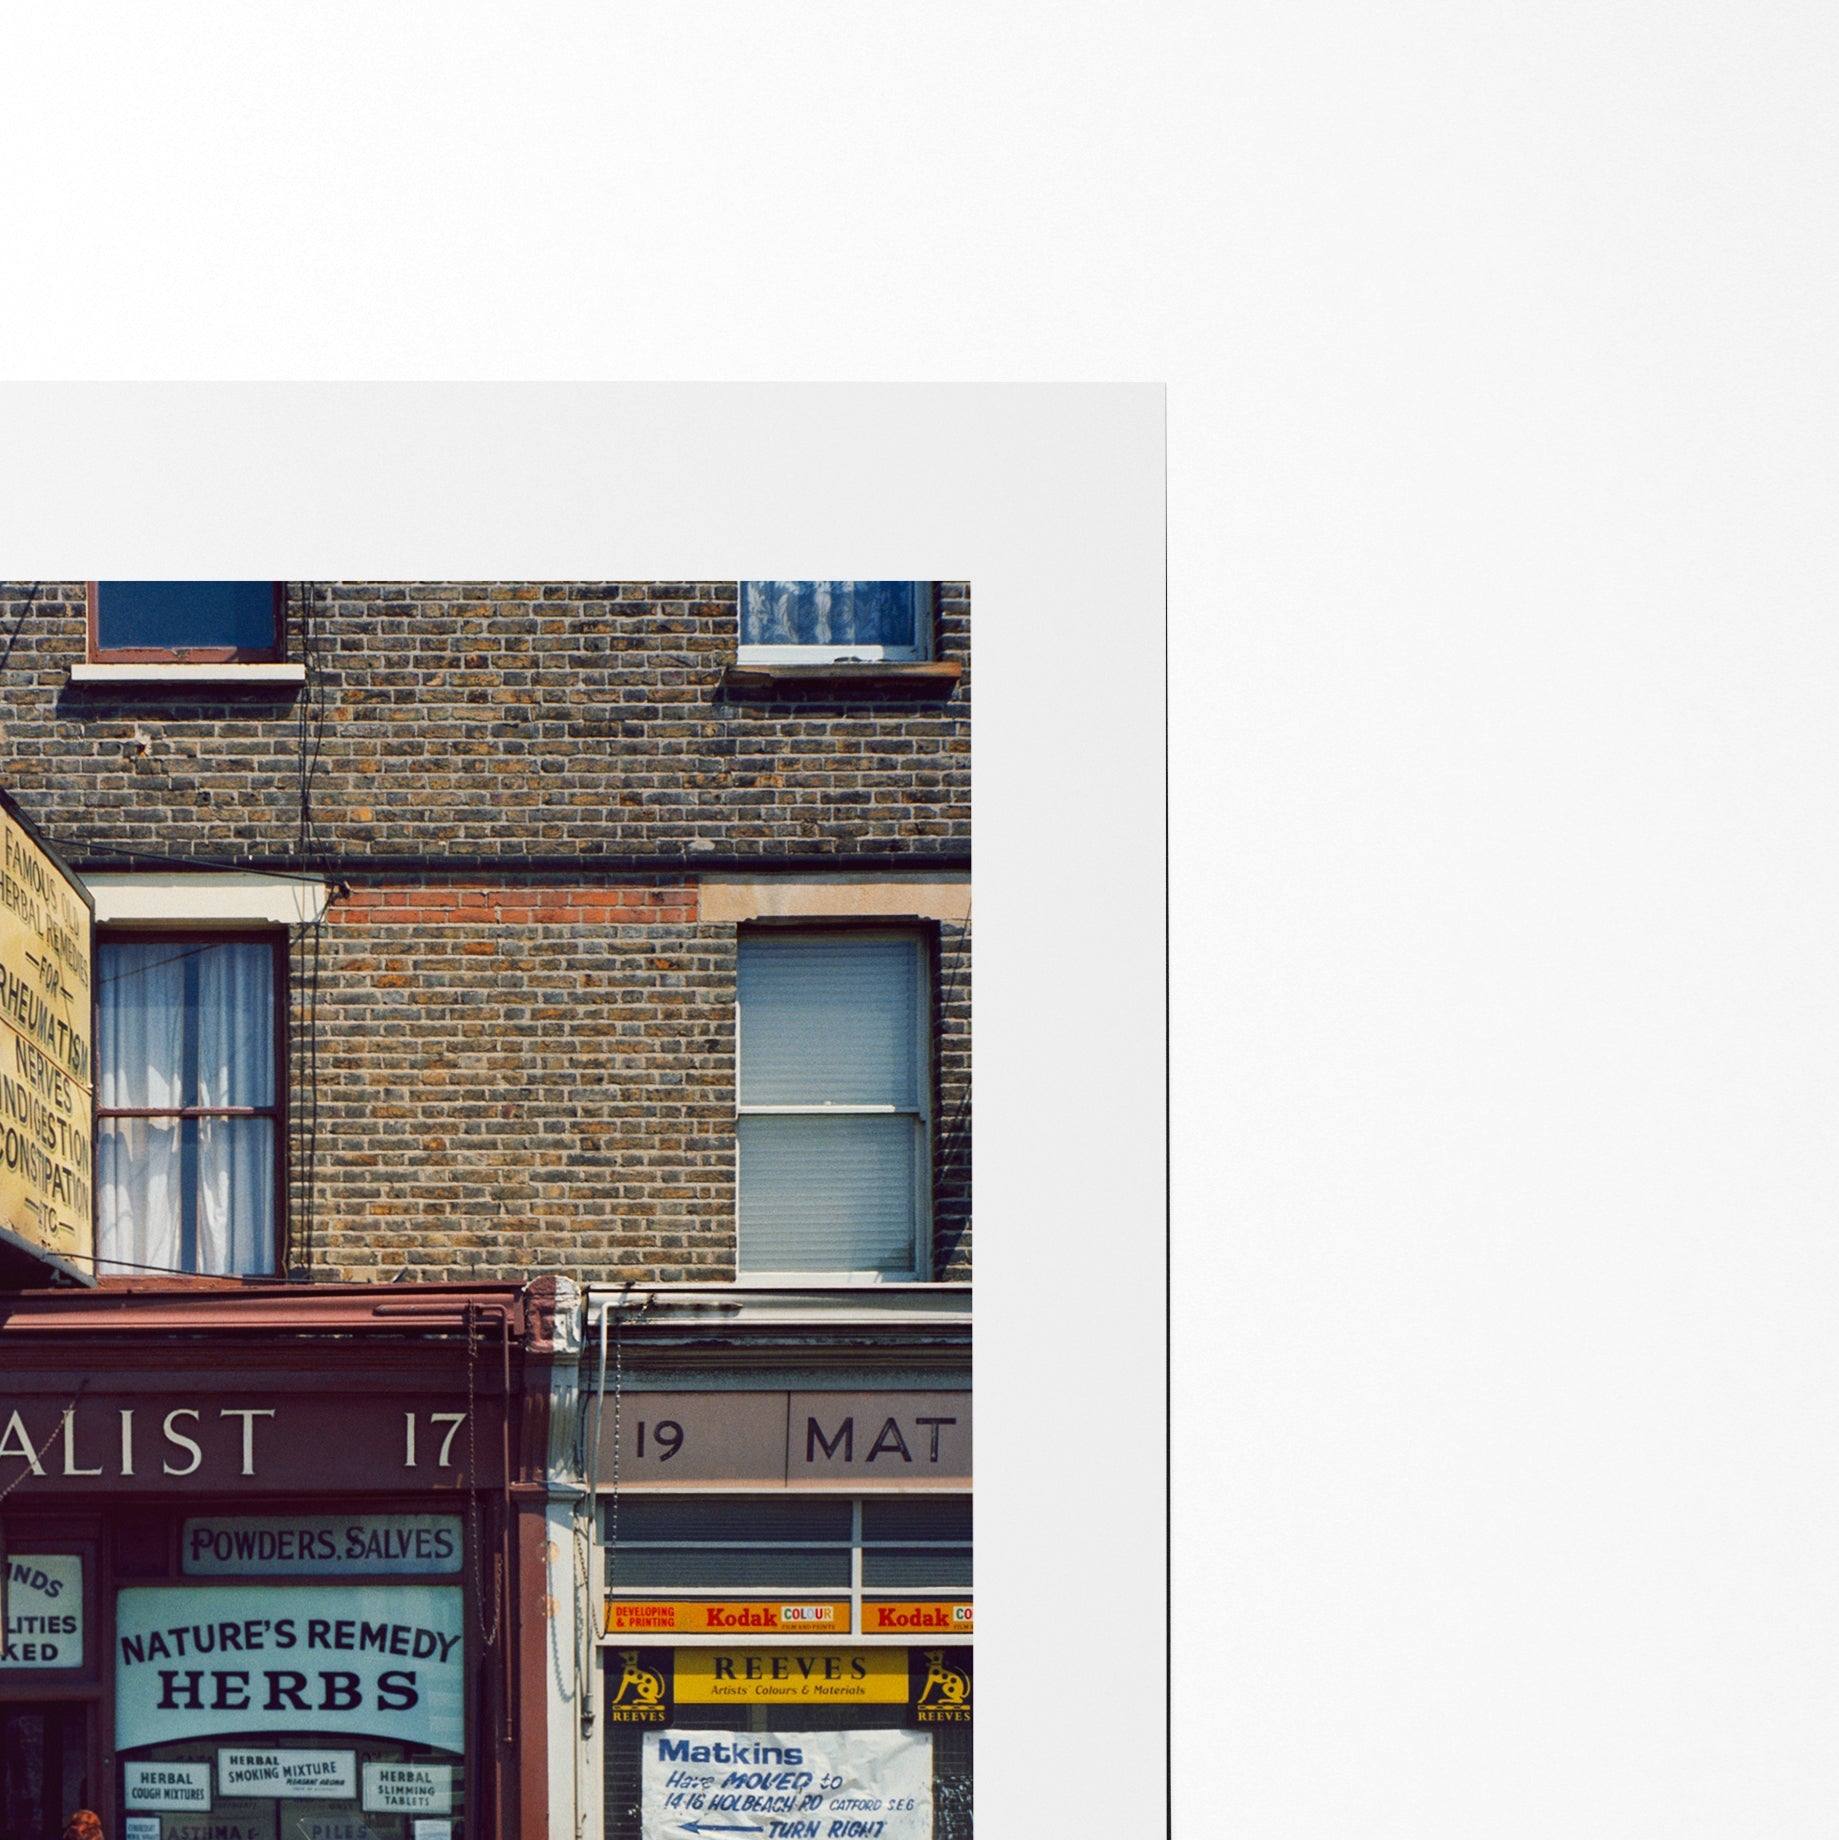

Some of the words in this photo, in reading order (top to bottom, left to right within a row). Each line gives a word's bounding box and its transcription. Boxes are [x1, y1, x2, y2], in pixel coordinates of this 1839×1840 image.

[5, 825, 57, 909] FAMOUS
[46, 914, 89, 990] REMEDIES
[39, 955, 59, 996] FOR
[16, 1035, 72, 1114] NERVES
[404, 1412, 467, 1467] 17
[636, 1420, 685, 1462] 19
[806, 1416, 957, 1463] MAT
[345, 1526, 454, 1559] SALVES
[616, 1607, 675, 1617] DEVELOPING
[706, 1608, 778, 1627] Kodak
[784, 1608, 832, 1620] COLOUR
[878, 1608, 949, 1626] Kodak
[616, 1617, 624, 1627] &
[629, 1617, 675, 1627] PRINTING
[121, 1619, 297, 1666] NATURE'S
[308, 1619, 461, 1663] REMEDY
[714, 1656, 866, 1680] REEVES
[157, 1670, 419, 1711] HERBS
[755, 1685, 797, 1695] Colours
[801, 1686, 809, 1695] &
[814, 1685, 865, 1695] Materials
[613, 1712, 665, 1721] REEVES
[919, 1711, 971, 1721] REEVES
[229, 1755, 280, 1766] HERBAL
[658, 1739, 803, 1765] Matkins
[141, 1772, 193, 1784] HERBAL
[229, 1767, 279, 1783] SMOKING
[283, 1761, 337, 1778] MIXTURE
[380, 1771, 432, 1783] HERBAL
[666, 1770, 715, 1789] Have
[721, 1771, 813, 1790] MOVED
[820, 1772, 843, 1790] to
[132, 1787, 161, 1799] COUGH
[164, 1788, 204, 1800] MIXTURES
[378, 1785, 435, 1796] SLIMMING
[385, 1796, 429, 1806] TABLETS
[708, 1794, 797, 1813] HOLBEACH
[801, 1795, 824, 1812] RD
[829, 1798, 882, 1811] CATFORD
[168, 1826, 242, 1840] ASTHMA
[312, 1825, 367, 1839] PILES
[768, 1820, 821, 1839] TURN
[828, 1821, 887, 1838] RIGHT
